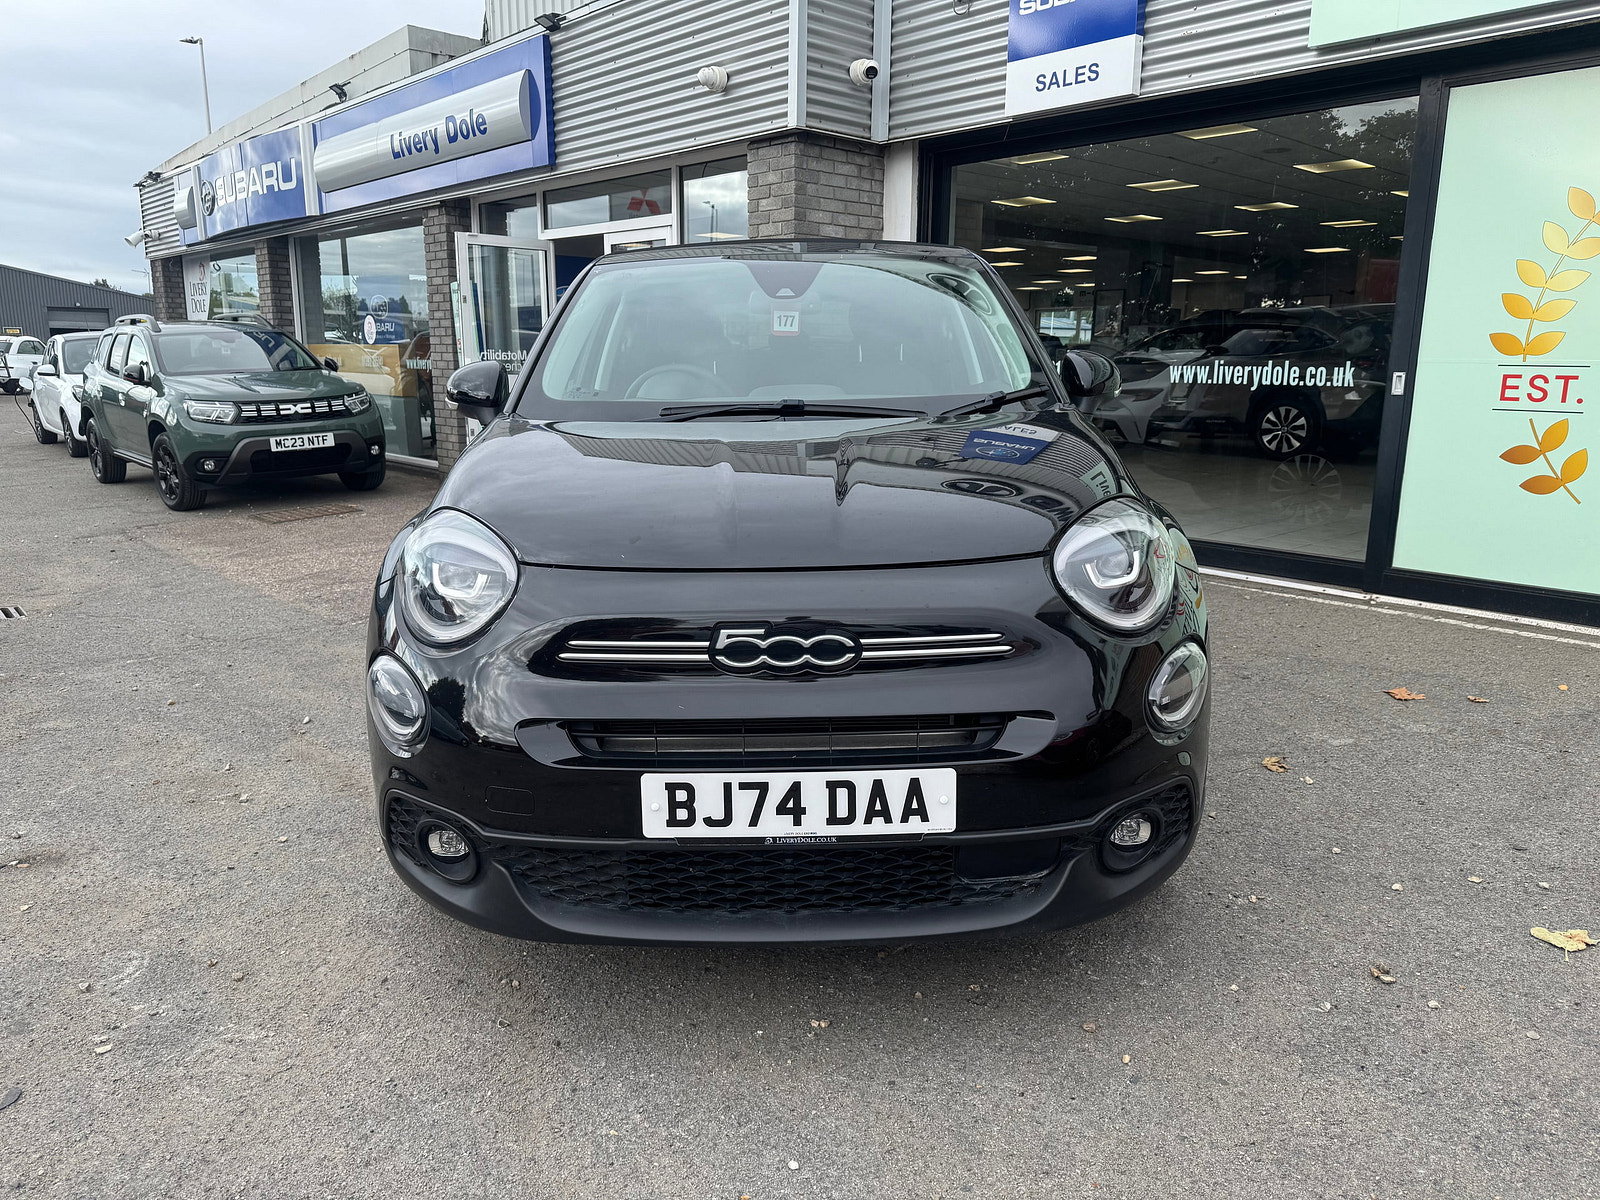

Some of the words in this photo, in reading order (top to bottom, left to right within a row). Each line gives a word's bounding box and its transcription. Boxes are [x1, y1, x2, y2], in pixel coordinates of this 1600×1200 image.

[1035, 63, 1100, 92] SALES
[390, 127, 440, 160] Livery
[445, 108, 488, 144] Dole
[215, 157, 297, 207] SUBARU
[190, 281, 208, 297] LIVERY
[191, 298, 207, 313] DOLE
[777, 314, 795, 328] 177
[1169, 359, 1356, 391] www.liverydole.co.uk
[1499, 373, 1584, 404] EST.
[274, 437, 305, 450] MC23
[307, 434, 328, 447] NTF
[714, 628, 855, 668] 500
[664, 780, 807, 828] BJ74
[825, 777, 930, 826] DAA
